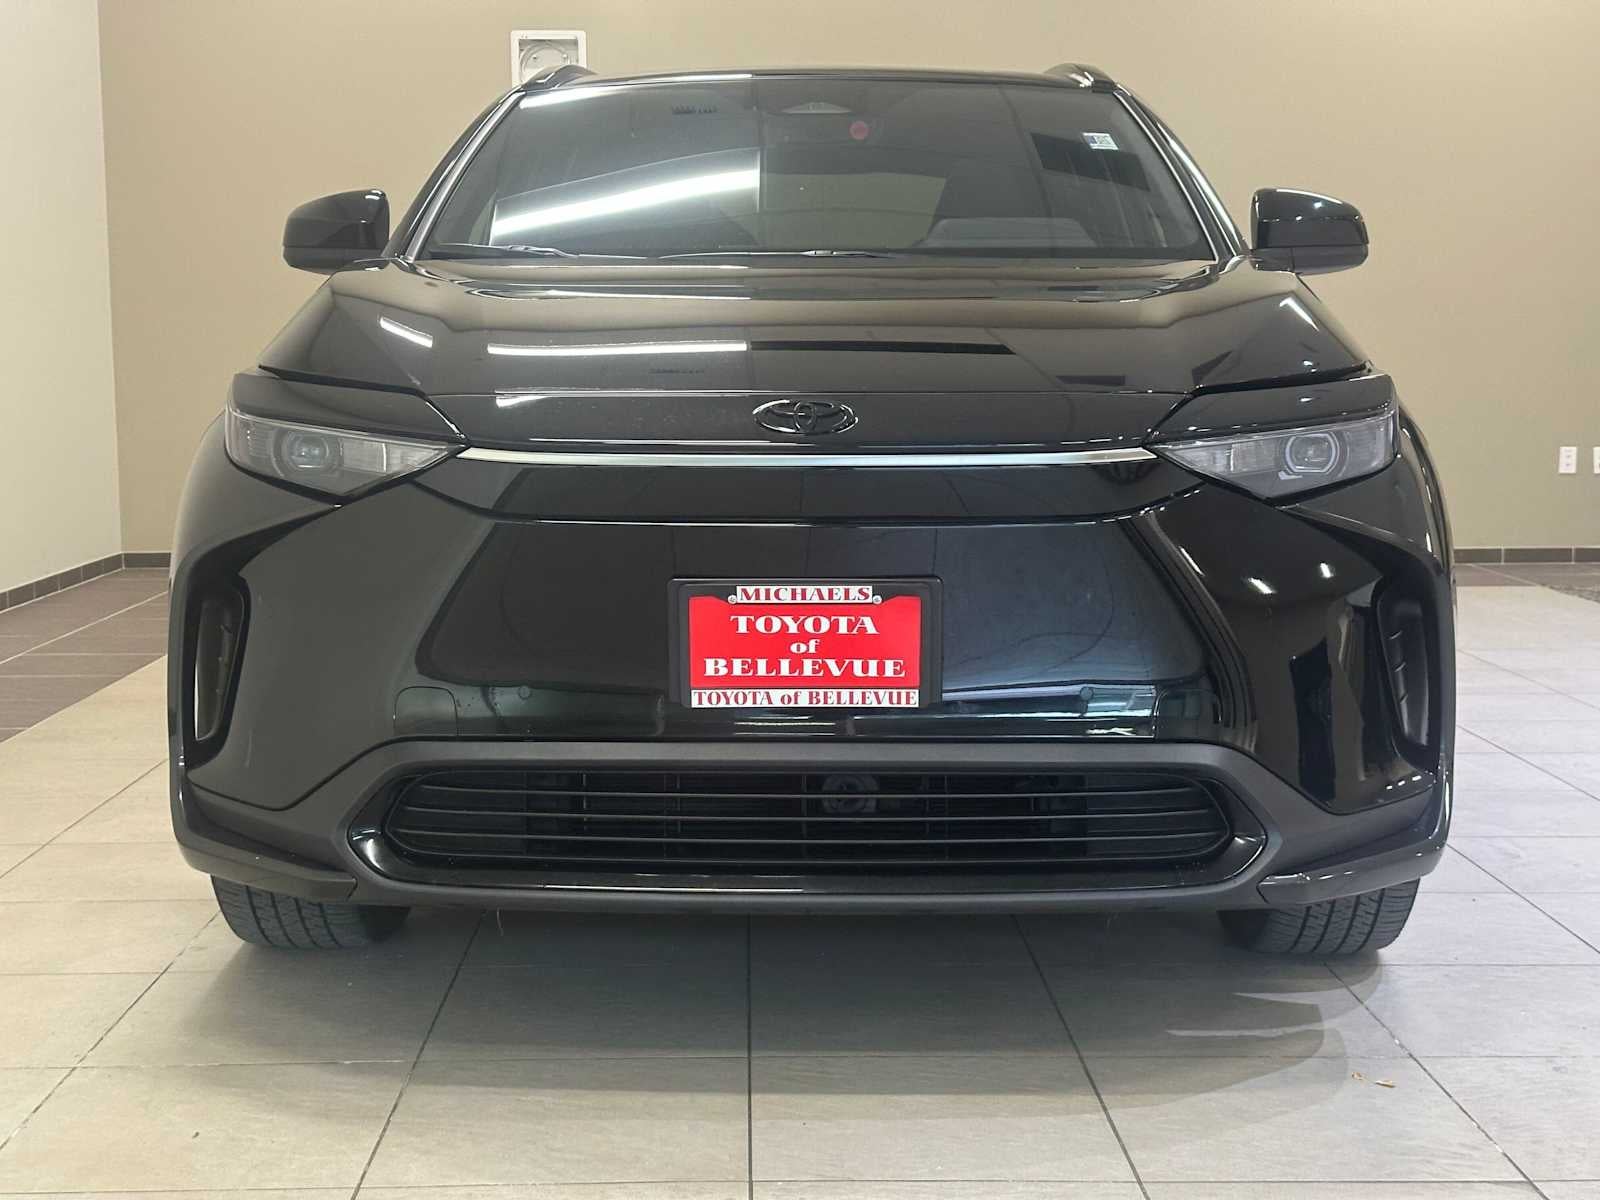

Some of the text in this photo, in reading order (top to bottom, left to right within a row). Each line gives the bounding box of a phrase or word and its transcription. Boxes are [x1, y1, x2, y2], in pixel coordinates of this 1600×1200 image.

[740, 587, 870, 601] MICHAELS
[730, 615, 880, 634] TOYOTA
[789, 639, 821, 654] of
[703, 658, 906, 677] BELLEVUE
[693, 691, 917, 705] TOYOTA of BELLEVUE
